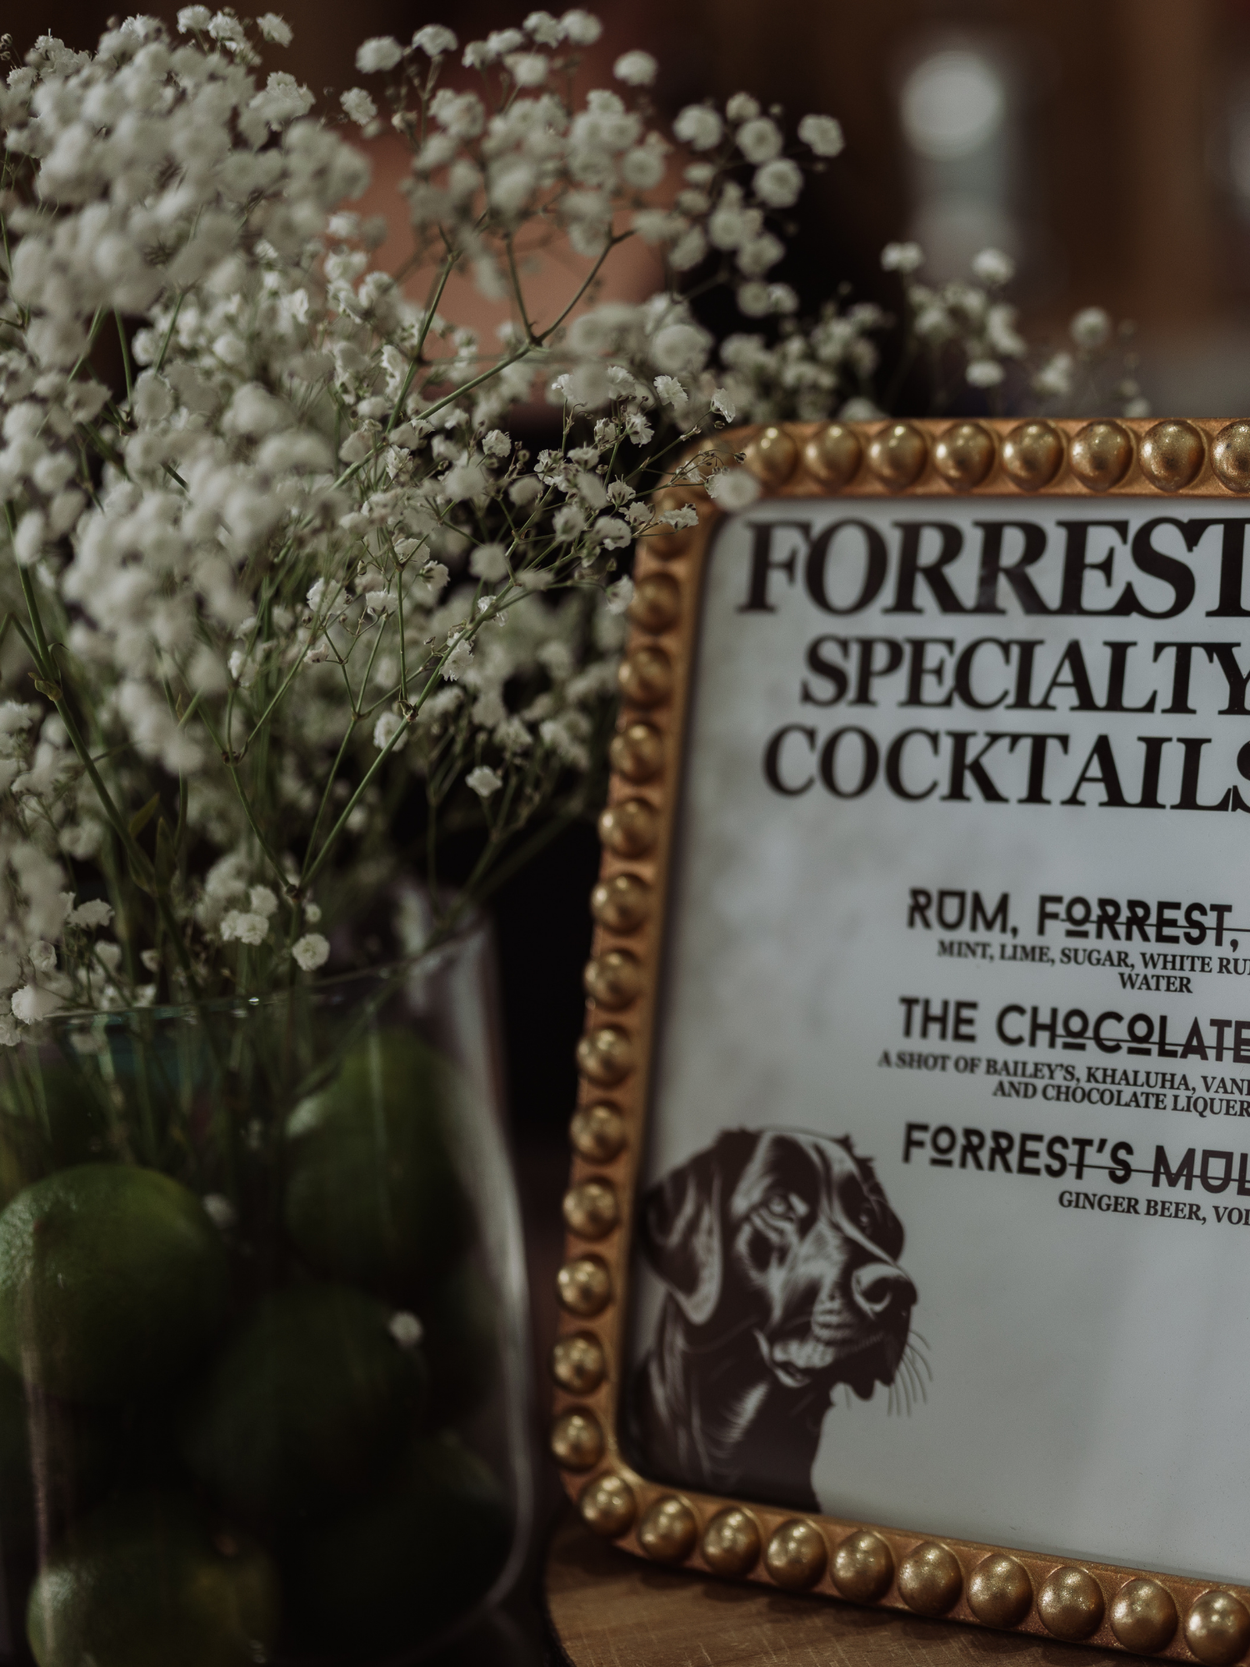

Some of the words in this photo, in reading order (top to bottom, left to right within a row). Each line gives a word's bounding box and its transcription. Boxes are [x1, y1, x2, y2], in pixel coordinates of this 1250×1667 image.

[906, 886, 1020, 940] RUM,
[1036, 894, 1240, 953] FORREST,
[937, 939, 995, 963] MINT,
[999, 944, 1056, 969] LIME,
[1059, 948, 1136, 972] SUGAR,
[1140, 952, 1213, 974] WHITE
[1117, 971, 1193, 994] WATER
[898, 996, 979, 1043] THE
[877, 1050, 893, 1068] A
[895, 1051, 951, 1073] SHOT
[953, 1056, 981, 1075] OF
[985, 1058, 1081, 1085] BAILEY'S,
[1085, 1066, 1197, 1096] KHALUHA,
[992, 1080, 1038, 1101] AND
[1041, 1083, 1168, 1111] CHOCOLATE
[902, 1120, 1135, 1185] FORREST'S
[1057, 1189, 1140, 1216] GINGER
[1144, 1197, 1207, 1225] BEER,
